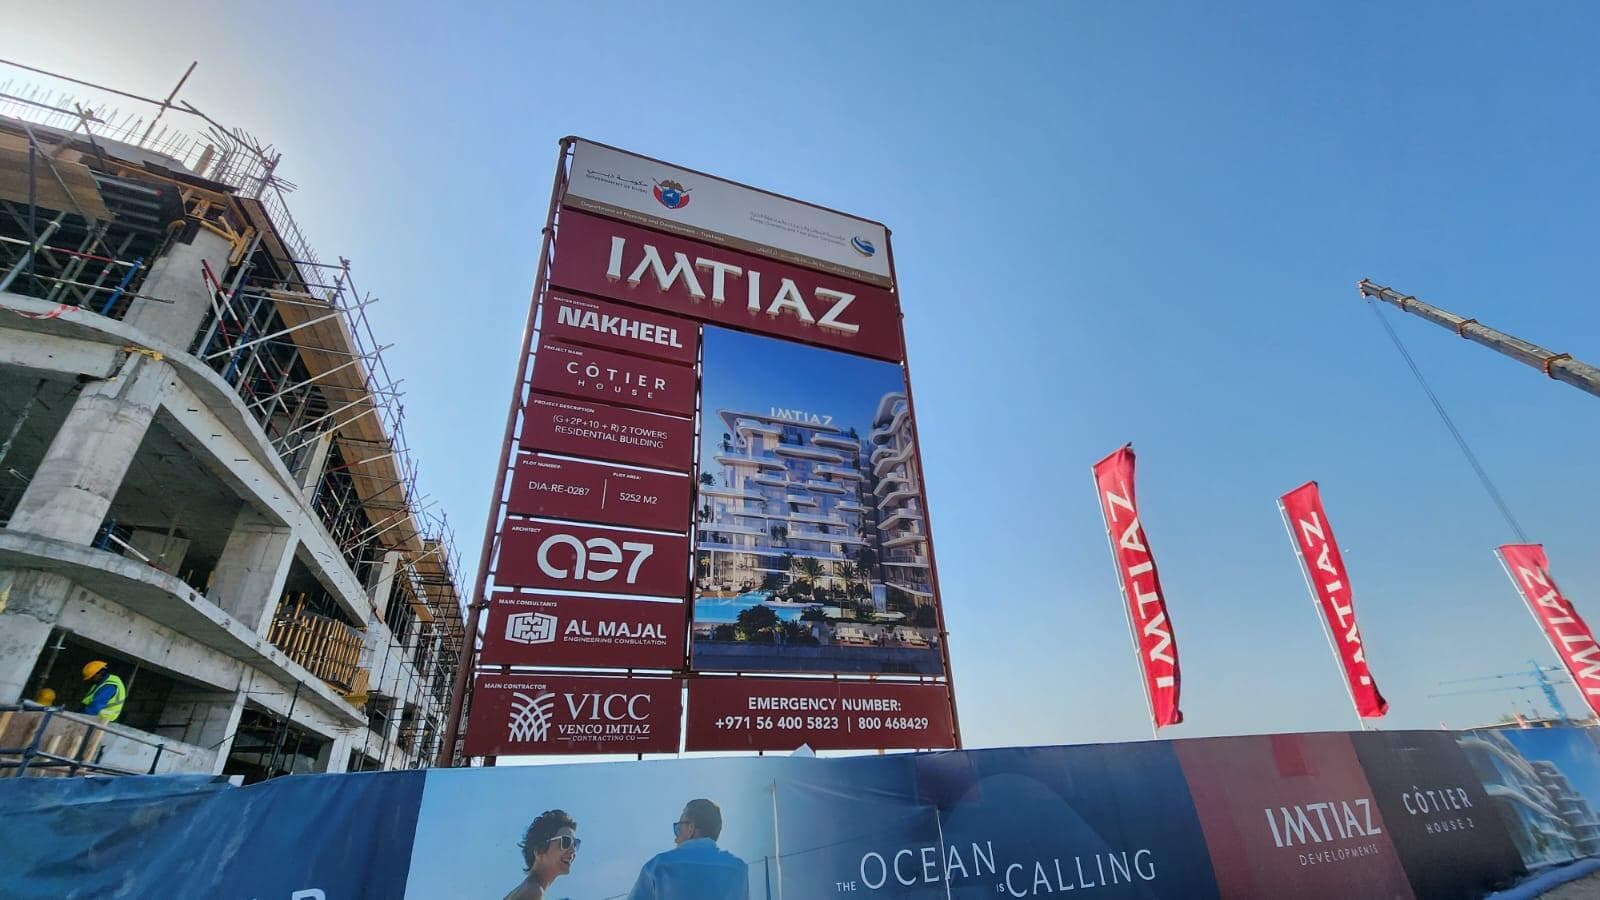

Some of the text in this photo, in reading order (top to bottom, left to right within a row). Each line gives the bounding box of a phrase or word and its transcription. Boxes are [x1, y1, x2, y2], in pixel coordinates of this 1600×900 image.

[606, 236, 860, 334] IMTIAZ
[557, 305, 683, 348] NAKHEEL
[566, 361, 666, 391] CÔTIER
[577, 379, 654, 399] HOUSE
[533, 399, 595, 413] PROJECT DESCRIPTION
[770, 406, 834, 426] IMTIAZ
[555, 425, 665, 449] RESIDENTIAL BUILDING
[621, 425, 627, 434] 2
[629, 426, 668, 440] TOWERS
[522, 459, 537, 467] PLOT
[528, 481, 591, 497] DIA-RE-0287
[619, 491, 658, 505] 5252 M2
[1105, 480, 1175, 688] IMTIAZ
[516, 600, 558, 608] CONSULTANTS
[564, 619, 667, 639] AL MAJAL
[563, 636, 668, 647] ENGINEERING CONSULTATION
[484, 682, 547, 691] MAIN CONTRACTOR
[563, 693, 651, 721] VICC
[748, 697, 902, 712] EMERGENCY NUMBER:
[558, 724, 650, 735] VENCO IMTIAZ
[715, 716, 929, 730] +971 56 400 5823 800 468429
[1402, 785, 1474, 816] CÔTIER
[1264, 799, 1382, 848] IMTIAZ
[1425, 817, 1476, 834] HOUSE 2
[1299, 843, 1380, 866] DEVELOPMENTS
[836, 881, 857, 893] THE
[860, 840, 997, 890] OCEAN
[1005, 849, 1156, 898] CALLING
